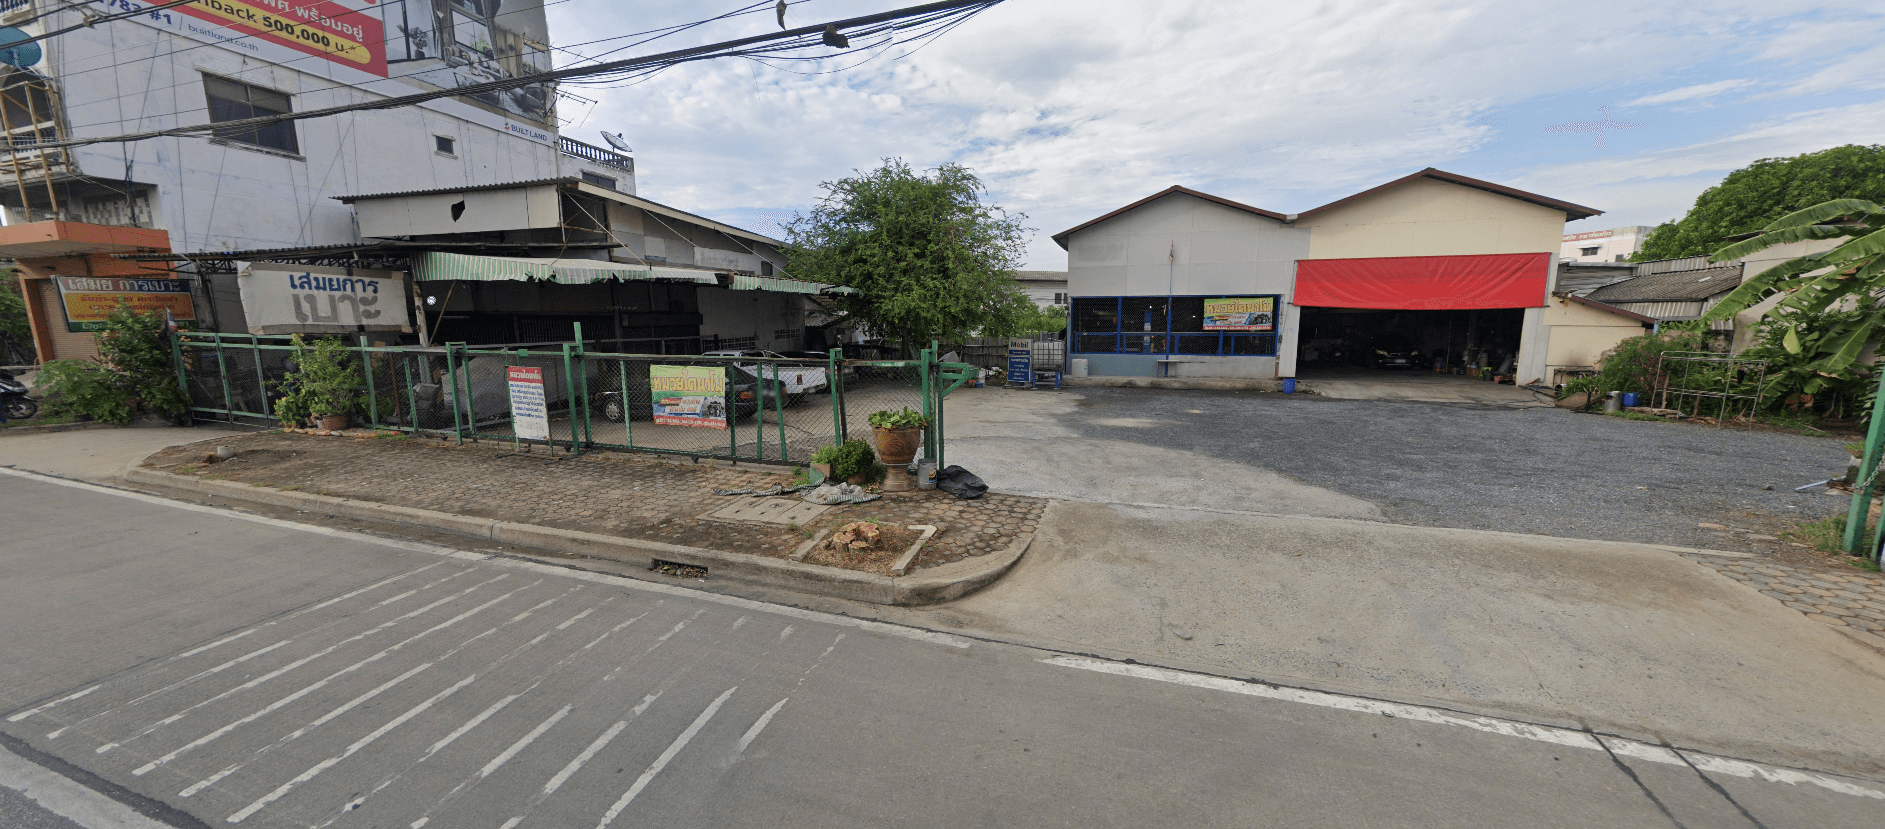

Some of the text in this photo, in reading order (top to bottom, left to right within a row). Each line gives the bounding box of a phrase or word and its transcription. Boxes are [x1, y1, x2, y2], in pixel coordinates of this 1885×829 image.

[510, 124, 548, 141] BUILT LAND
[68, 279, 181, 291] เสมย การเบาะ
[289, 272, 379, 294] เสมยการ
[291, 293, 381, 323] เบาะ
